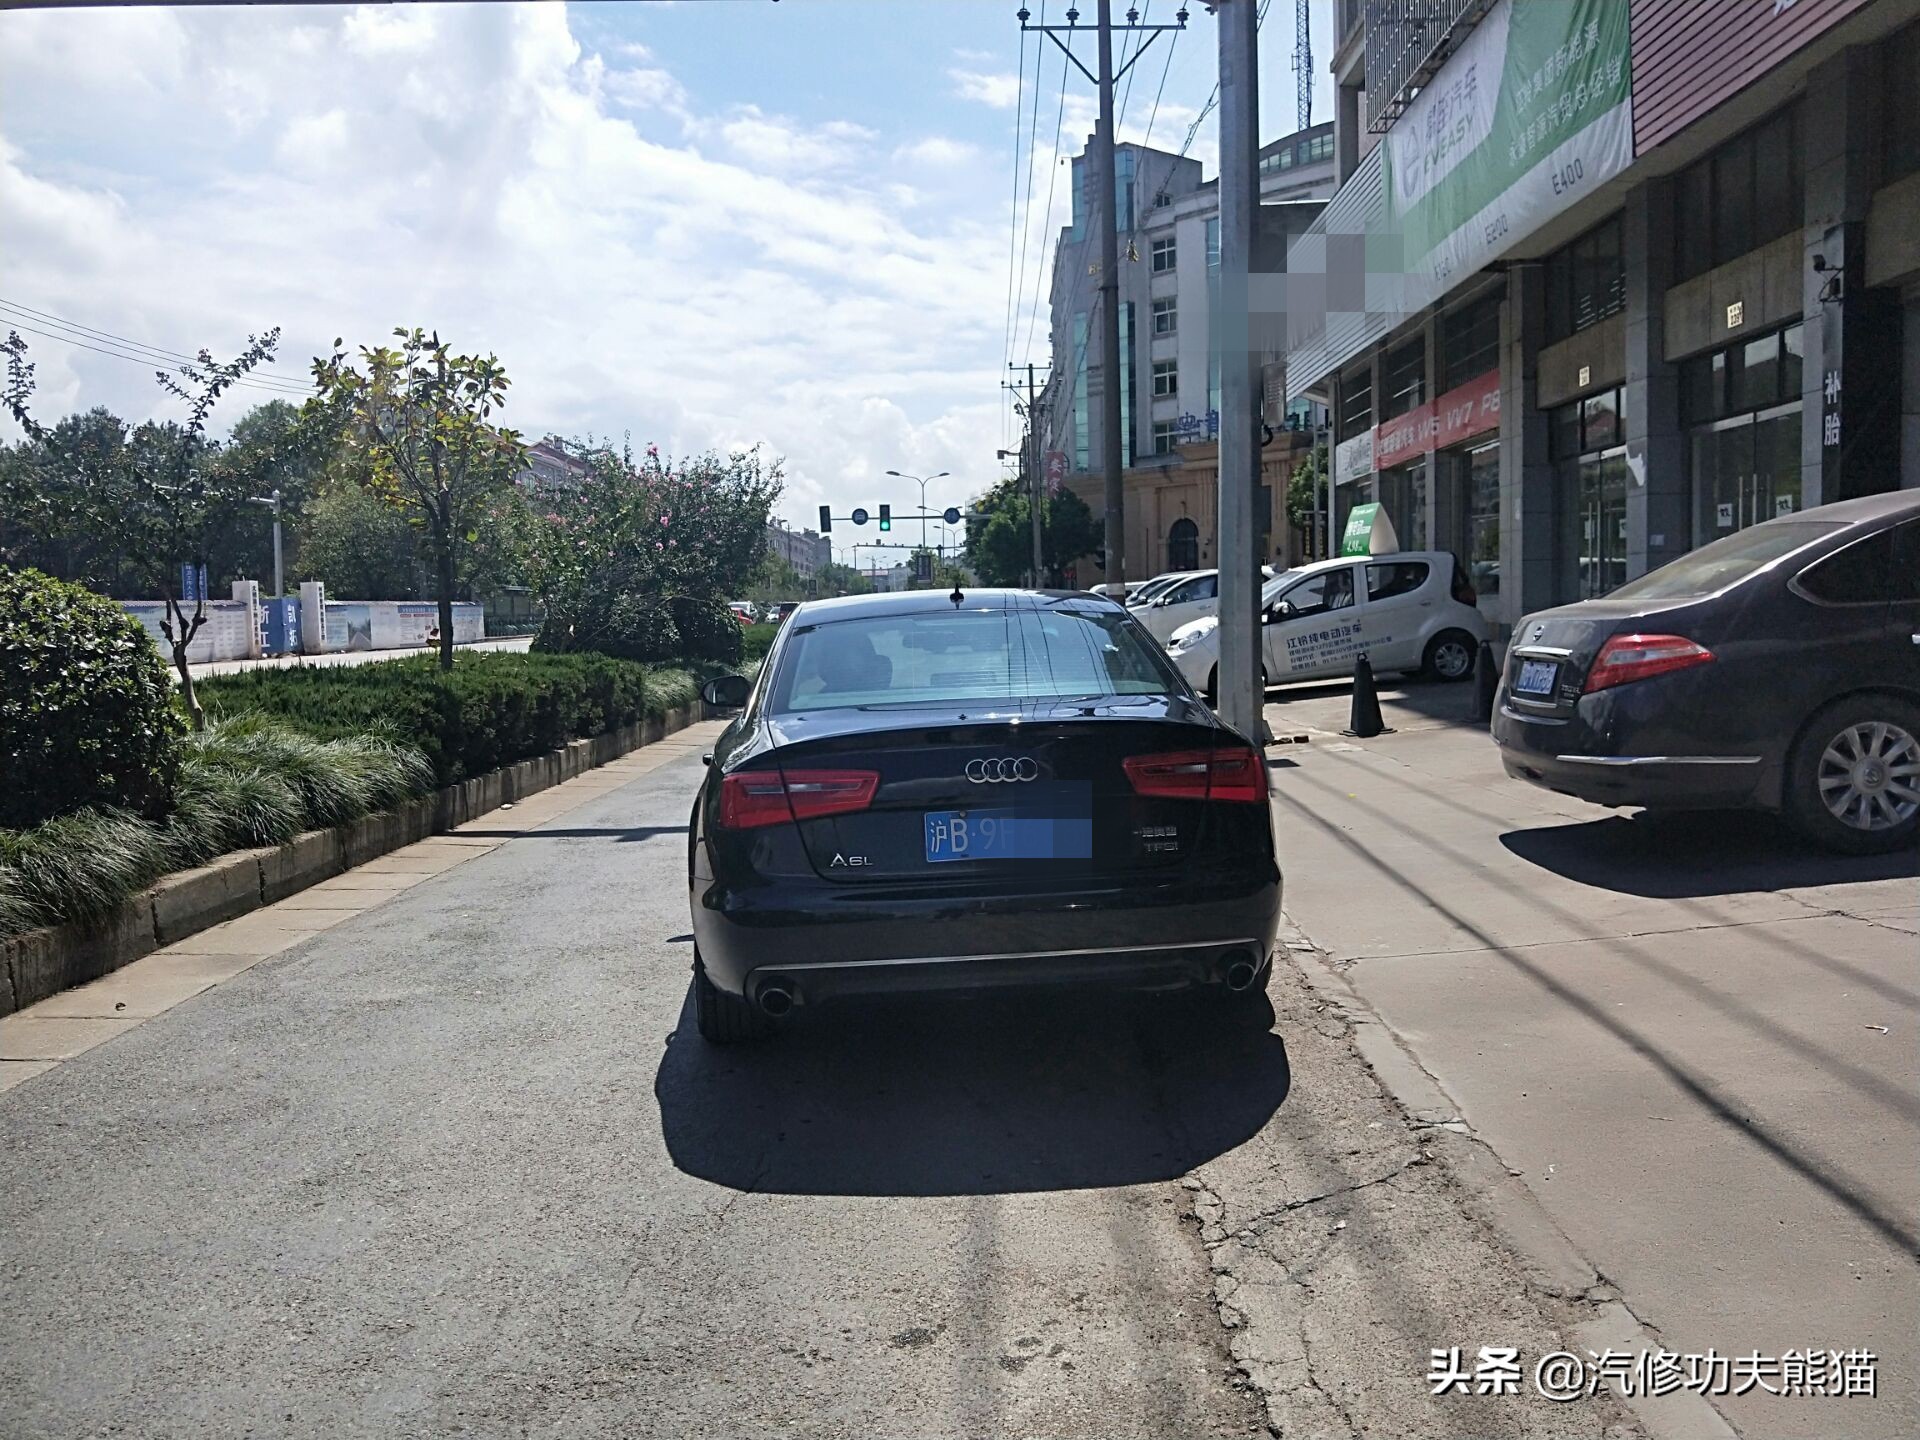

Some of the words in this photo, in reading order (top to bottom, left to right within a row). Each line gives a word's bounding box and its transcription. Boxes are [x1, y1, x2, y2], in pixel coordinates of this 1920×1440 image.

[1551, 158, 1584, 196] E400
[1824, 370, 1842, 446] 补胎
[1286, 619, 1363, 649] 江铃纯电动汽车
[829, 852, 874, 868] A6L
